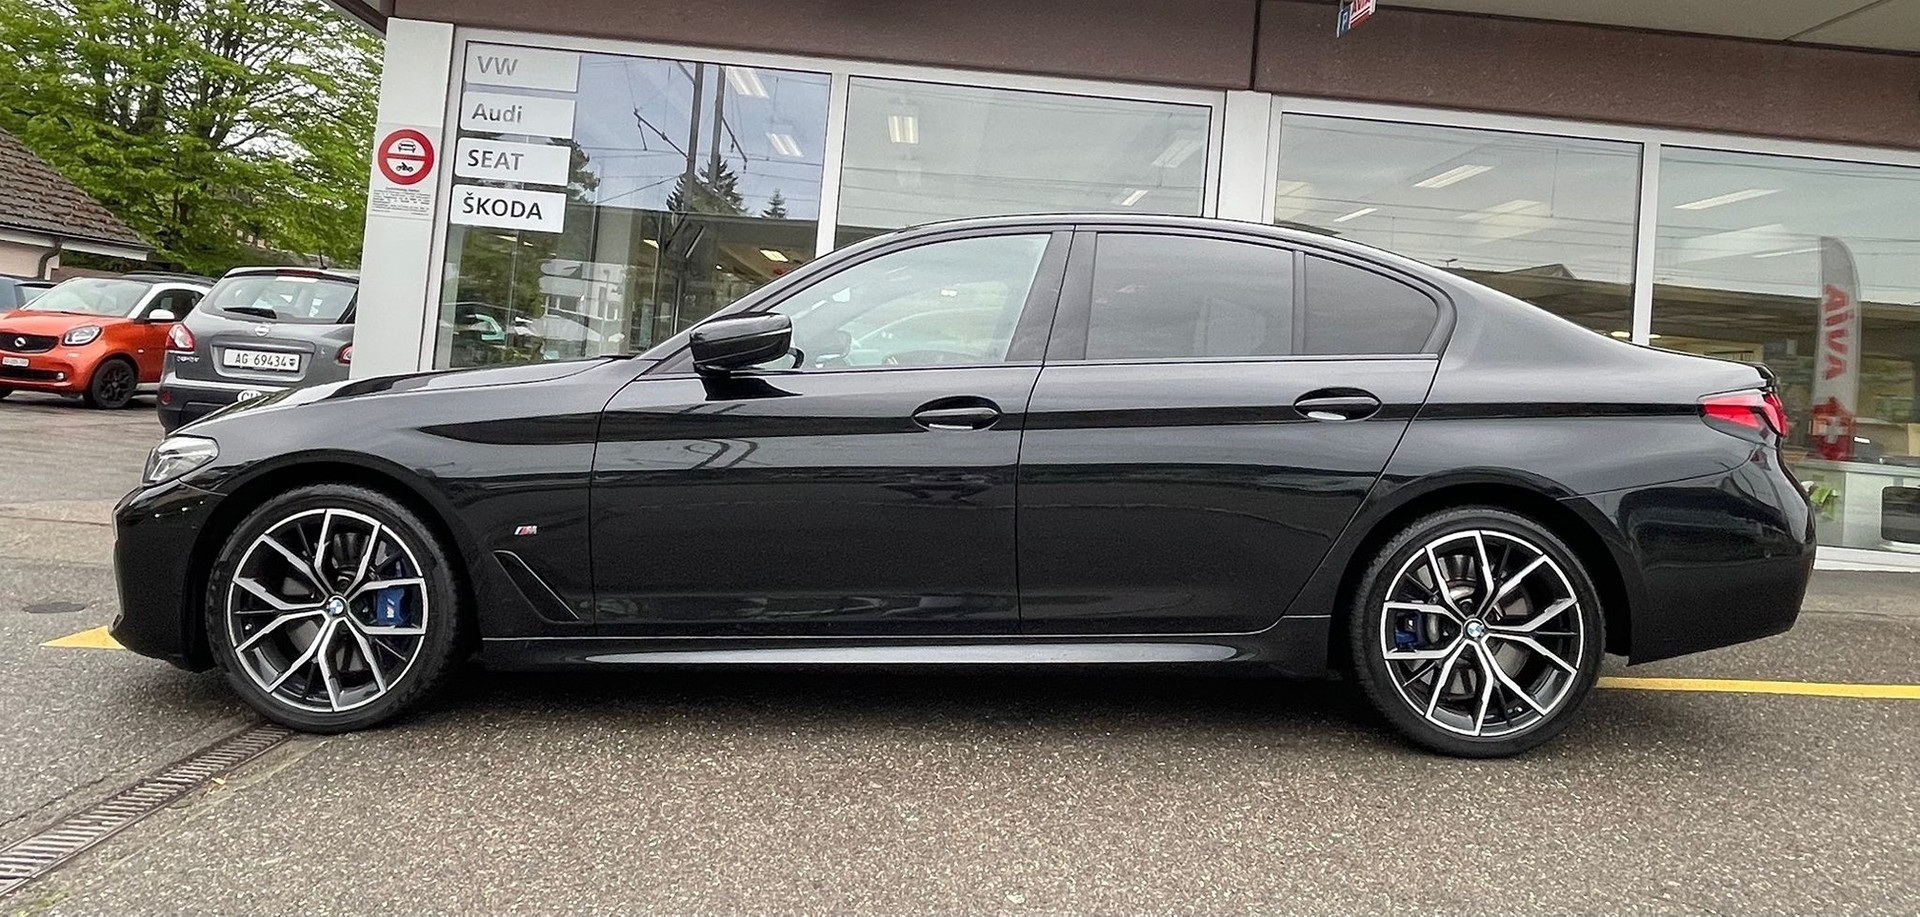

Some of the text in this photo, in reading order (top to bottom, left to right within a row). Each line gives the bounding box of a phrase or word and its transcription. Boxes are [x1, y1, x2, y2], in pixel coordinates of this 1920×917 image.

[477, 55, 519, 76] VW
[471, 103, 523, 123] Audi
[467, 149, 525, 171] SEAT
[462, 191, 543, 220] ŠKODA
[235, 353, 287, 367] AG 69434
